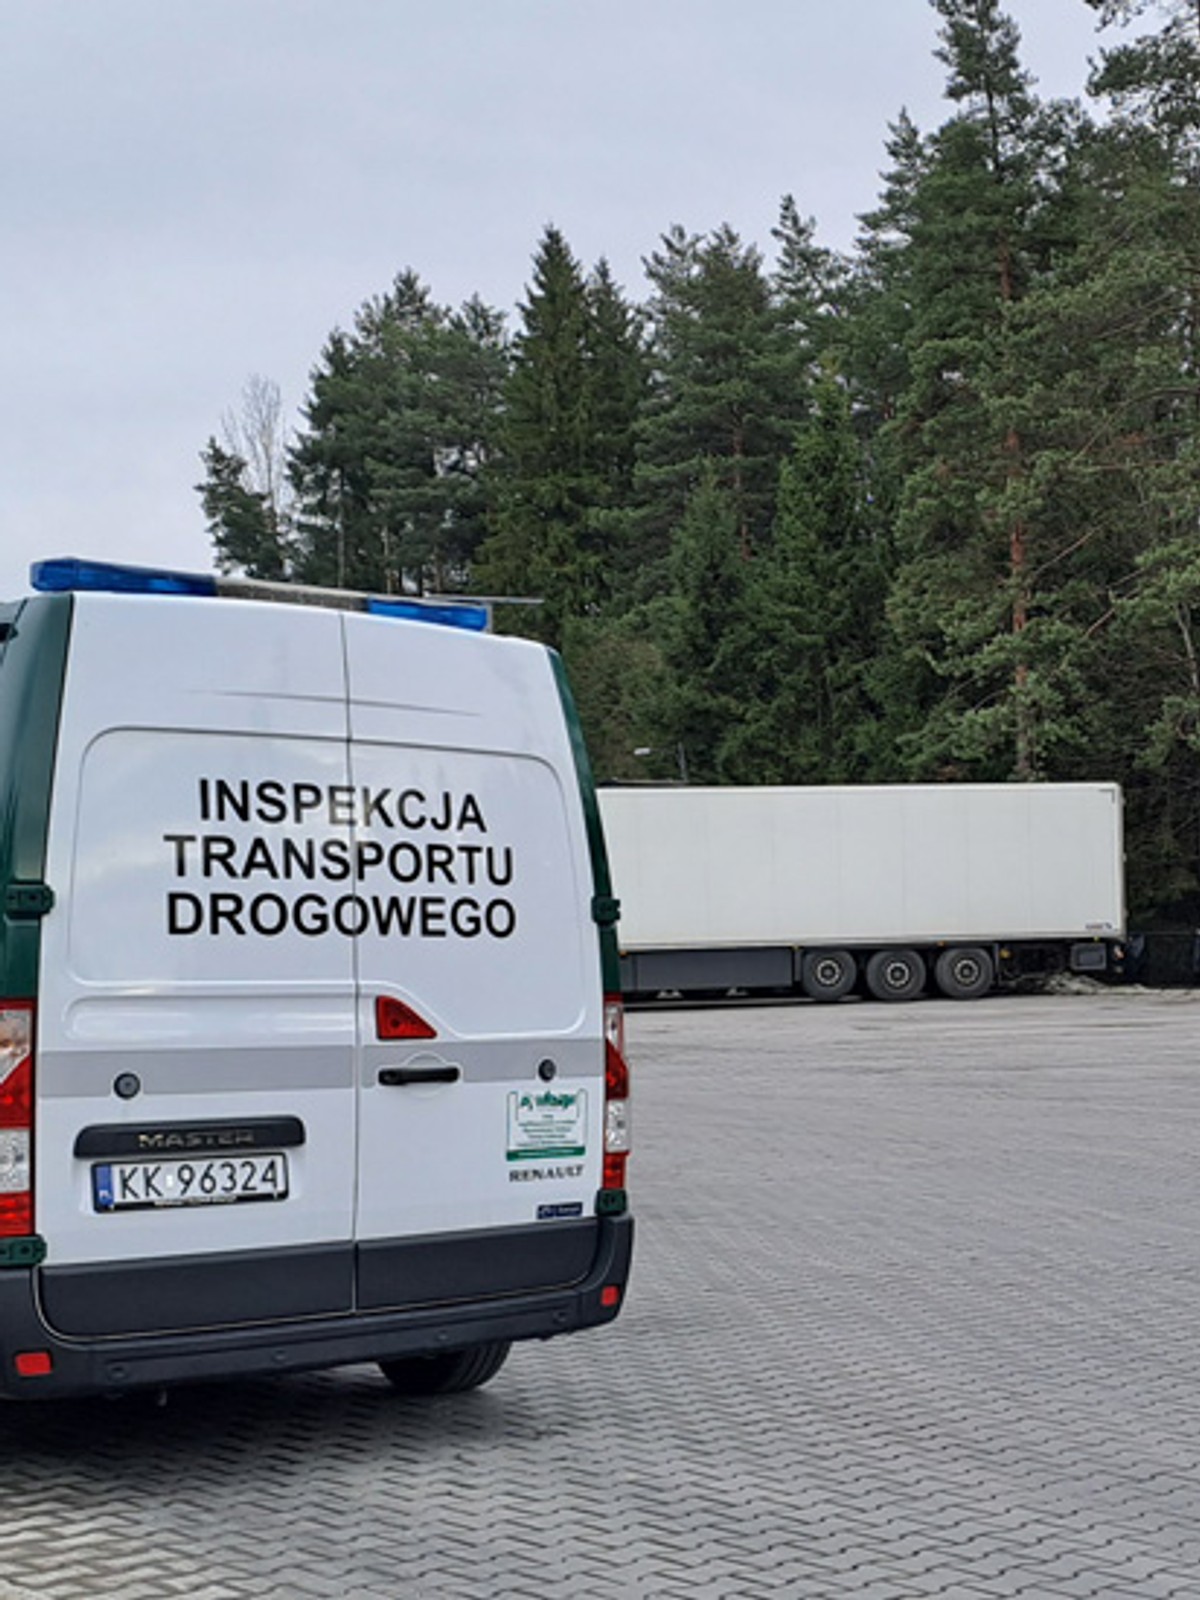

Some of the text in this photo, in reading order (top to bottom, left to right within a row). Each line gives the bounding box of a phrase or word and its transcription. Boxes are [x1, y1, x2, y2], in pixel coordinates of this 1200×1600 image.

[198, 778, 487, 833] INSPEKCJA
[163, 834, 513, 886] TRANSPORTU
[167, 892, 516, 939] DROGOWEGO
[137, 1130, 254, 1148] MASTER
[119, 1160, 277, 1200] KK 96324
[508, 1164, 584, 1182] RENAULT
